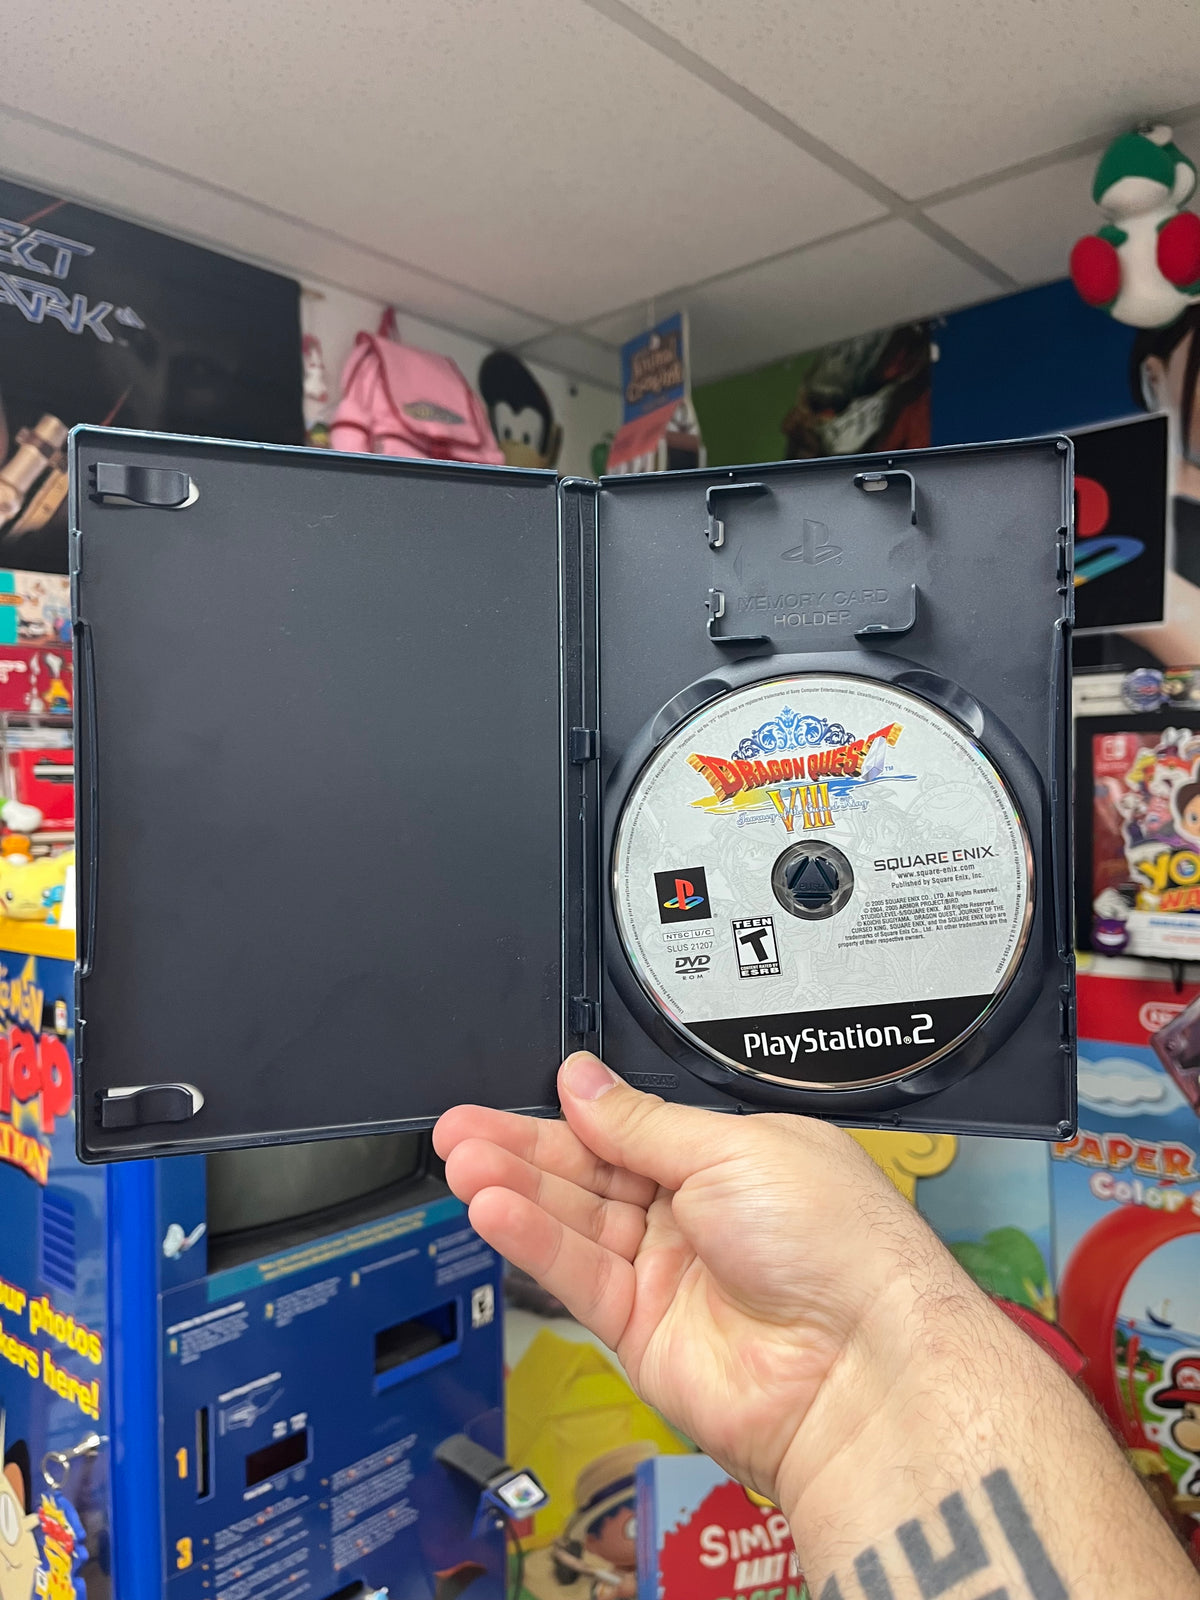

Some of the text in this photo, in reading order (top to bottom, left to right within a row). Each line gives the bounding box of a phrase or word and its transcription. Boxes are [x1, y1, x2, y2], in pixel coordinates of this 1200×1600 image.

[737, 588, 890, 613] MEMORY CARD
[773, 610, 852, 628] HOLDER
[688, 722, 904, 802] DRAGON QUEST
[767, 783, 835, 832] VIII
[840, 796, 869, 812] King
[874, 846, 994, 871] SQUARE ENIX
[897, 864, 975, 879] www.square-enix.com
[892, 880, 921, 888] Published
[932, 876, 954, 884] Square
[733, 918, 772, 928] TEEN
[666, 932, 690, 940] NTSC
[739, 928, 768, 962] T
[878, 936, 903, 944] respective
[666, 941, 714, 952] SLUS 21207
[675, 954, 711, 968] DVD
[741, 968, 780, 976] ESRB
[1053, 1131, 1197, 1181] PAPER
[1089, 1171, 1186, 1212] Color
[29, 1294, 103, 1365] photos
[43, 1348, 99, 1420] here!
